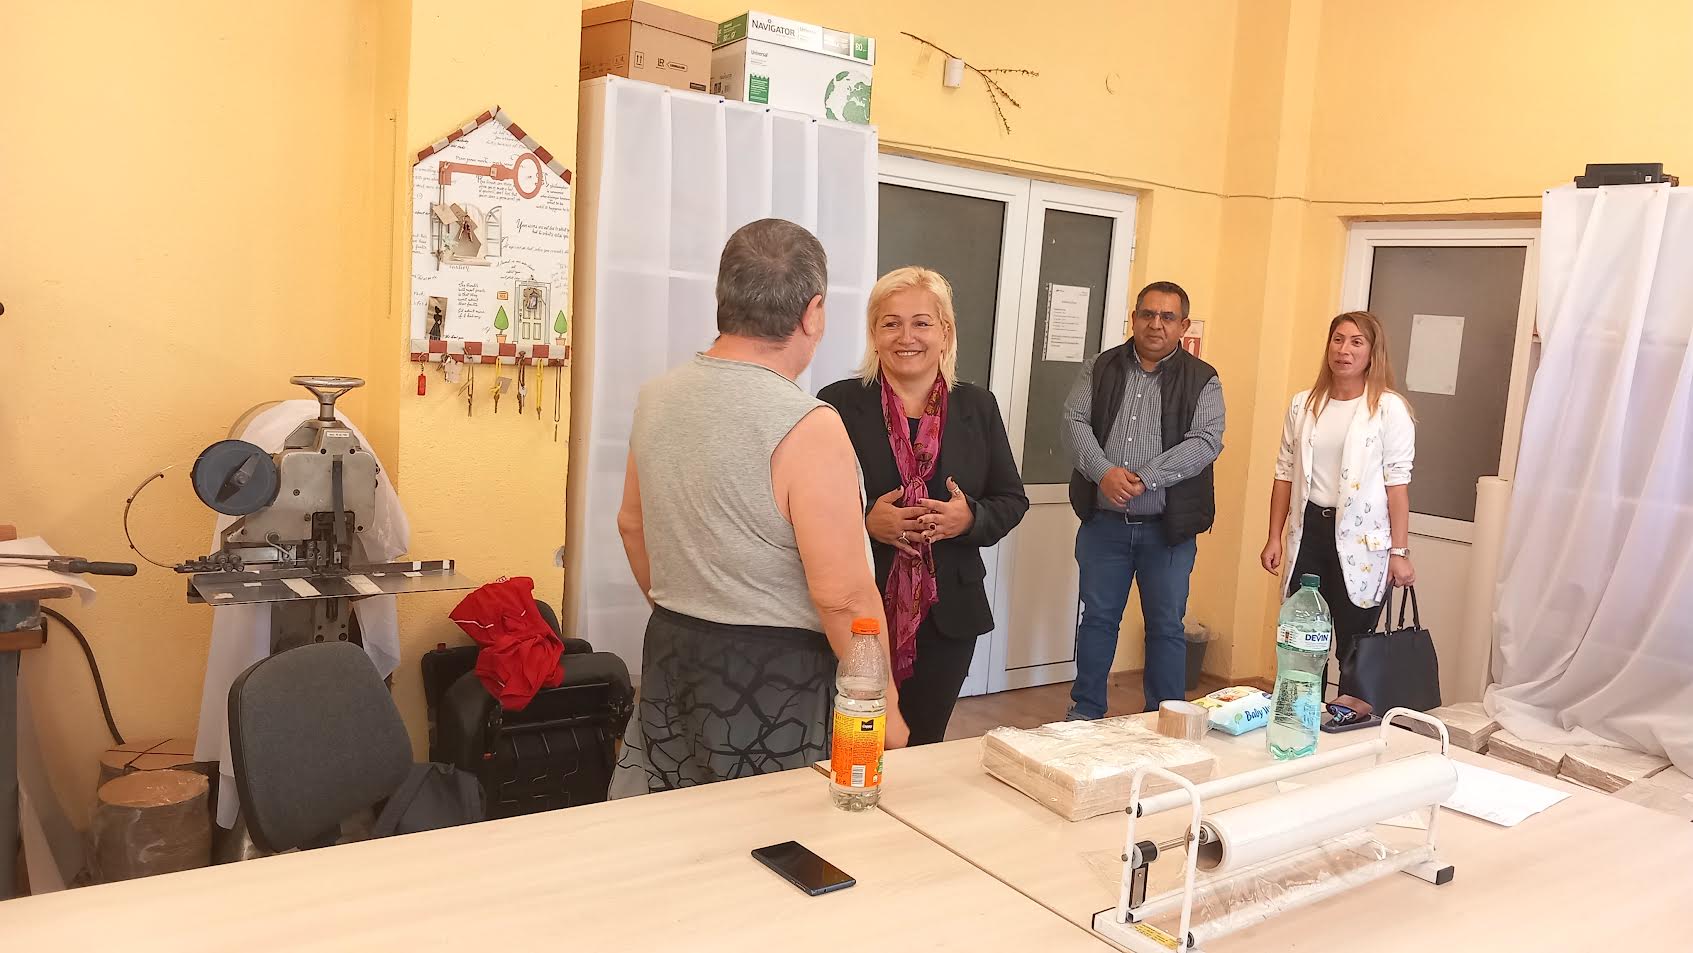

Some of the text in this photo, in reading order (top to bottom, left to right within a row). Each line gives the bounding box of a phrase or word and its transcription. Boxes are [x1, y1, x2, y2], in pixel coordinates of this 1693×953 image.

[751, 19, 796, 37] NAVIGATOR
[750, 49, 768, 58] Universal
[1305, 633, 1329, 642] DEVIN
[1244, 708, 1263, 722] Baby
